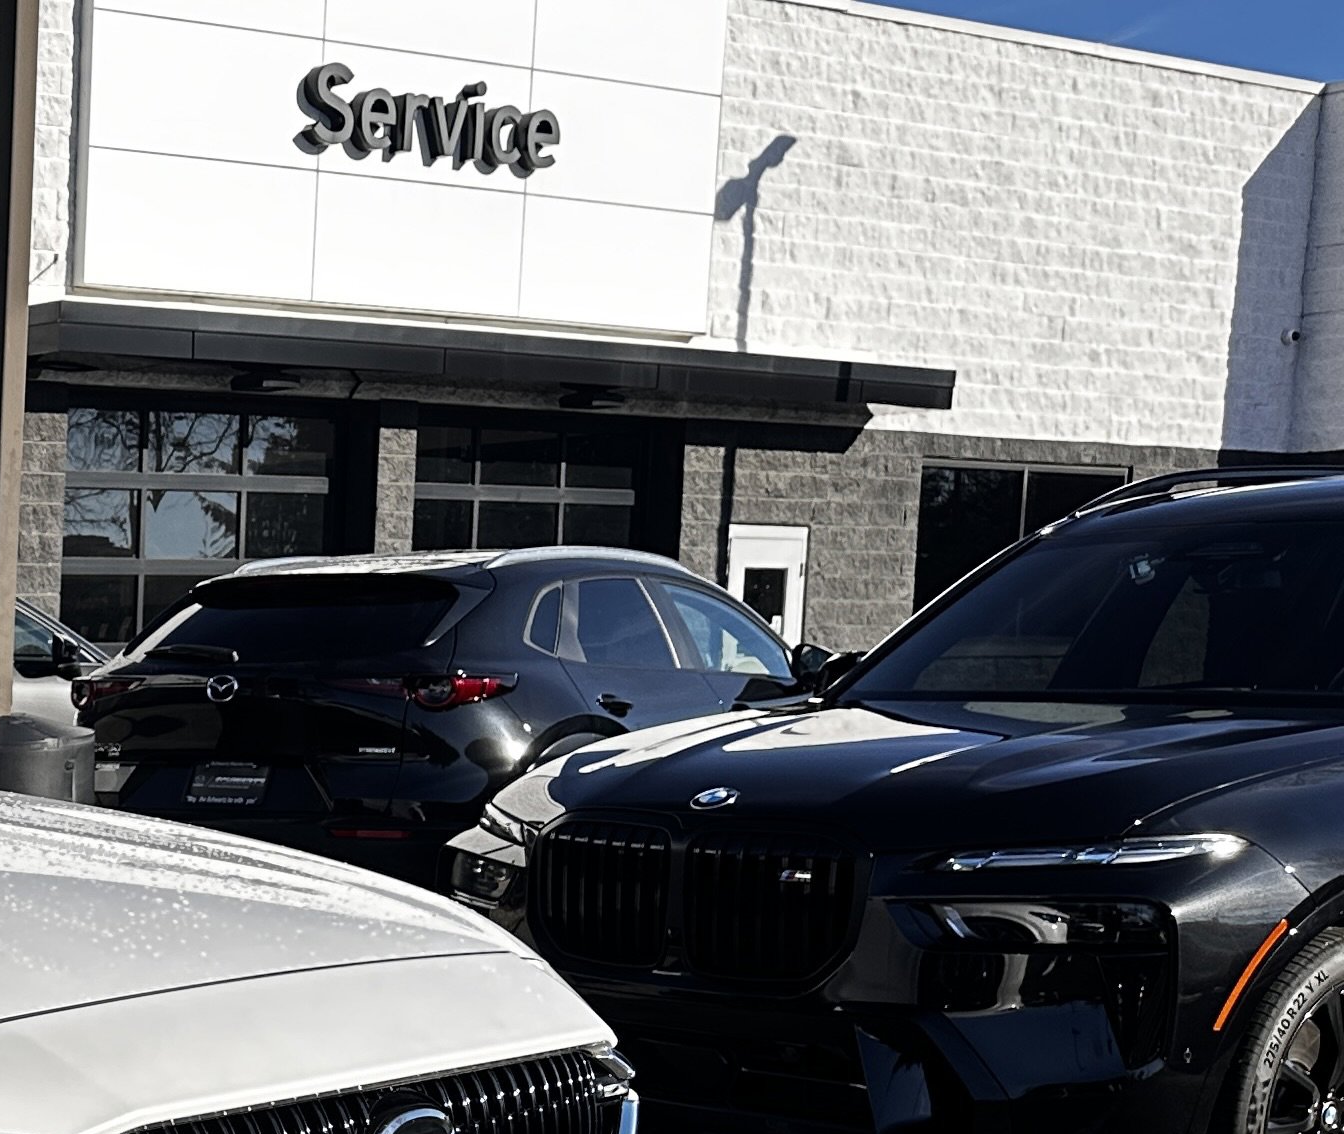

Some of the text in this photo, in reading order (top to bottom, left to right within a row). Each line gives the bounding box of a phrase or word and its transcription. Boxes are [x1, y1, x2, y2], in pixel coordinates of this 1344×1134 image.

[293, 62, 560, 179] Service
[1264, 1019, 1291, 1068] 275/40
[1314, 970, 1330, 986] XL
